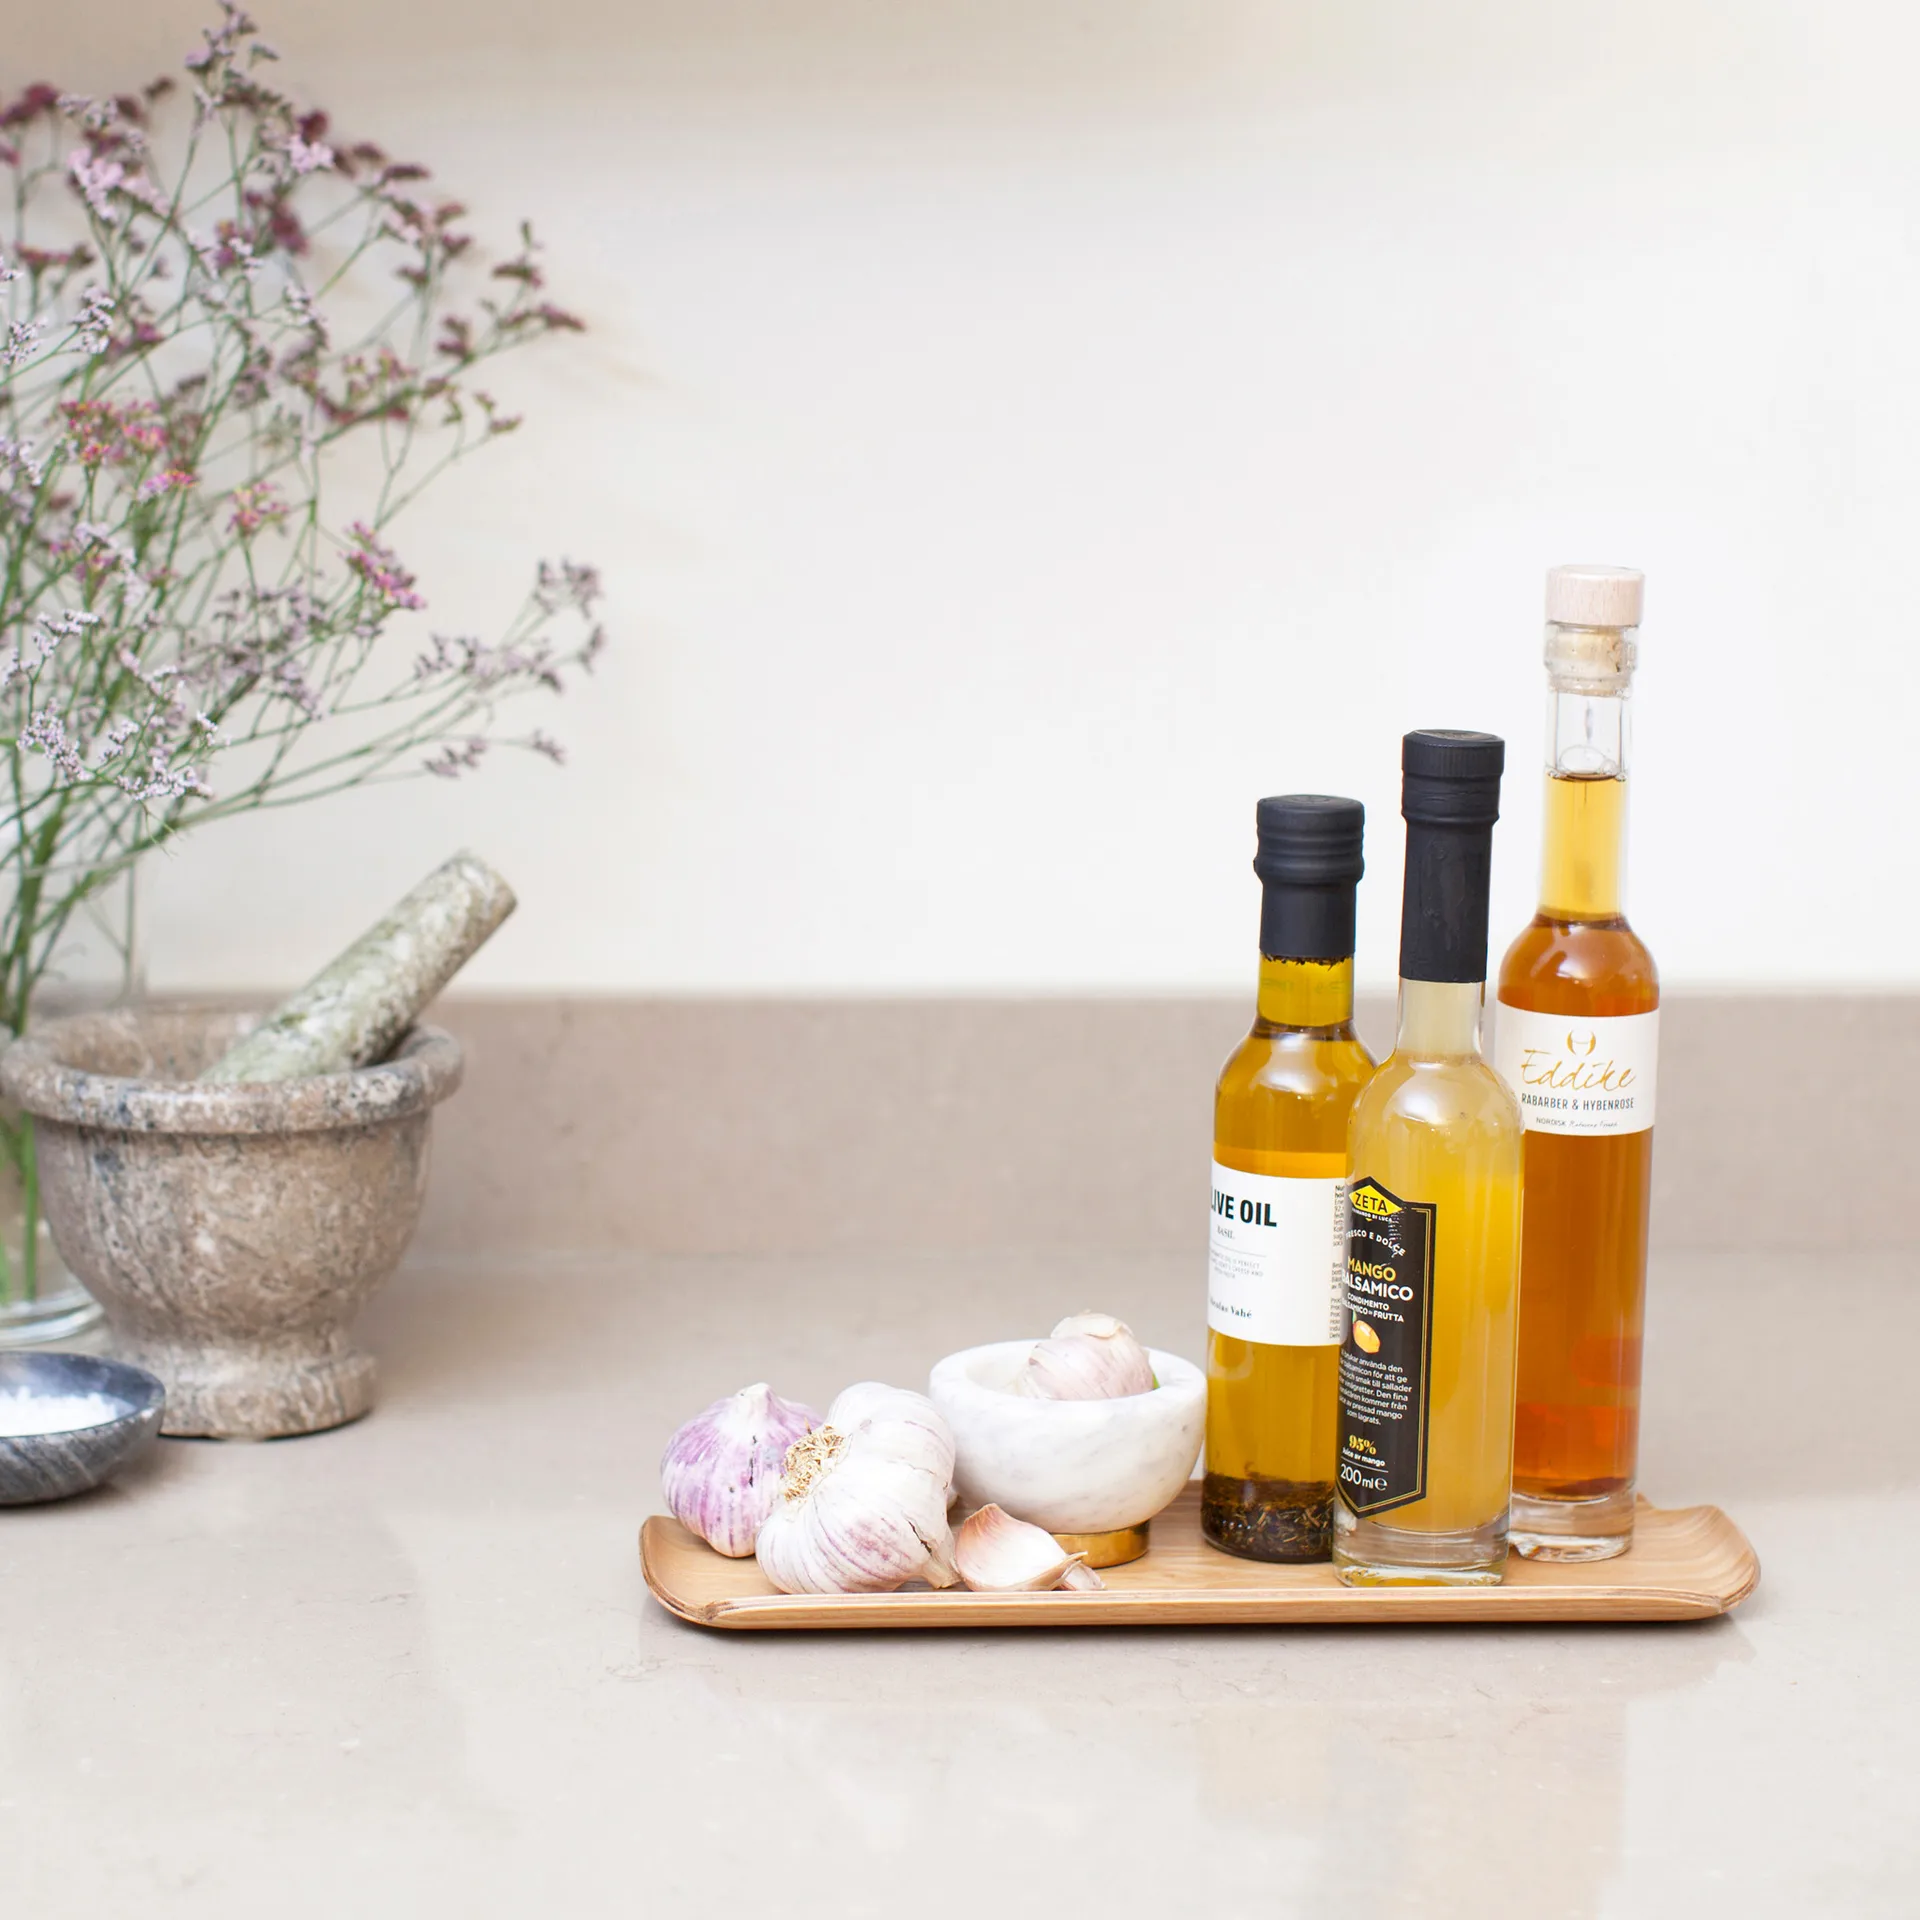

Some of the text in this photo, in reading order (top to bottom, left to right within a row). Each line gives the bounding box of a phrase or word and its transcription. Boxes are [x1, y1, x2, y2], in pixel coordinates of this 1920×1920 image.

[1520, 1049, 1636, 1091] Eddike
[1521, 1092, 1634, 1111] RABARBER & HYBENROSE
[1355, 1192, 1388, 1213] ZETA
[1240, 1199, 1277, 1227] OIL
[1369, 1231, 1374, 1240] E
[1348, 1255, 1396, 1282] MANGO
[1347, 1293, 1390, 1311] CONDIMENTO
[1373, 1310, 1405, 1323] FRUTTA
[1388, 1364, 1403, 1373] den
[1373, 1370, 1383, 1379] för
[1384, 1373, 1396, 1381] att
[1396, 1375, 1408, 1384] ge
[1371, 1379, 1381, 1388] till
[1381, 1382, 1413, 1392] sallader
[1361, 1395, 1390, 1408] kommer
[1390, 1401, 1408, 1410] från
[1376, 1389, 1392, 1399] Den
[1393, 1392, 1409, 1402] fina
[1376, 1409, 1403, 1420] mango
[1349, 1434, 1377, 1455] 95%
[1361, 1455, 1386, 1467] mango
